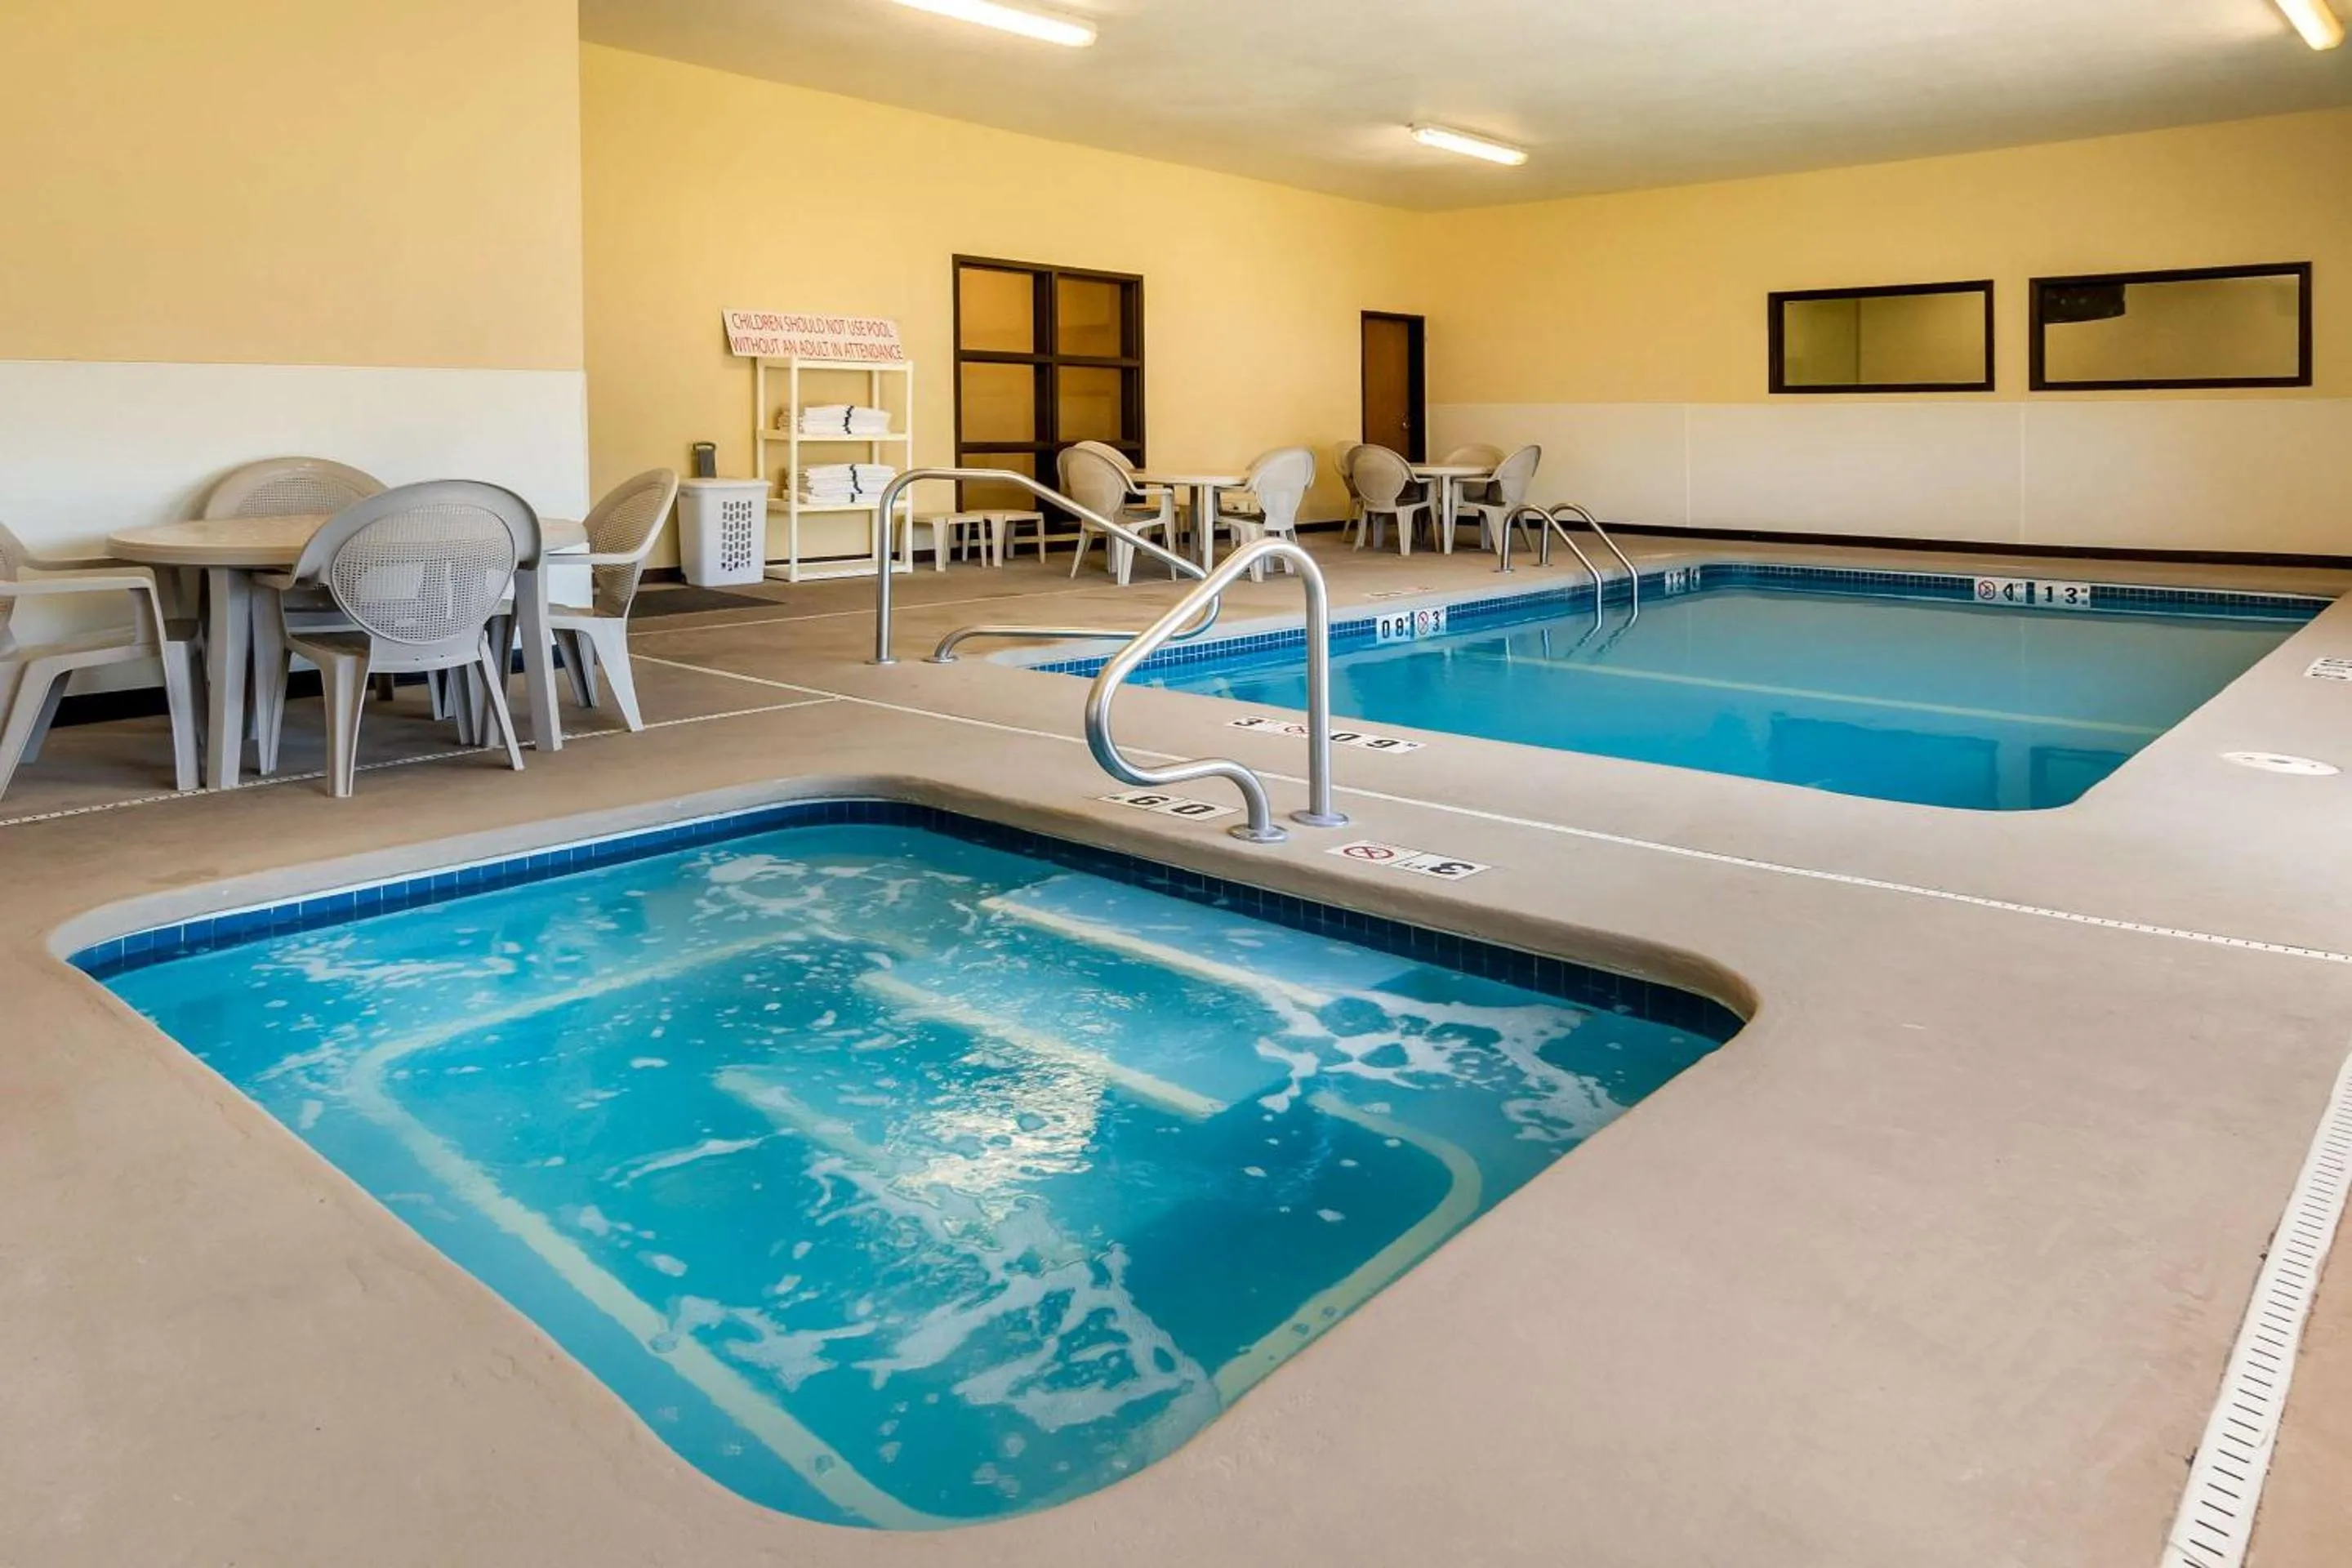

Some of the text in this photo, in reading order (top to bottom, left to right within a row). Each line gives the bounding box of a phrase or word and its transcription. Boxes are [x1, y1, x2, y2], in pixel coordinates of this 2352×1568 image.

[732, 313, 893, 338] CHILDREN SHOULD NOT USE POOL
[733, 336, 903, 360] WITHOUT AN ADULT IN ATTENDANCE
